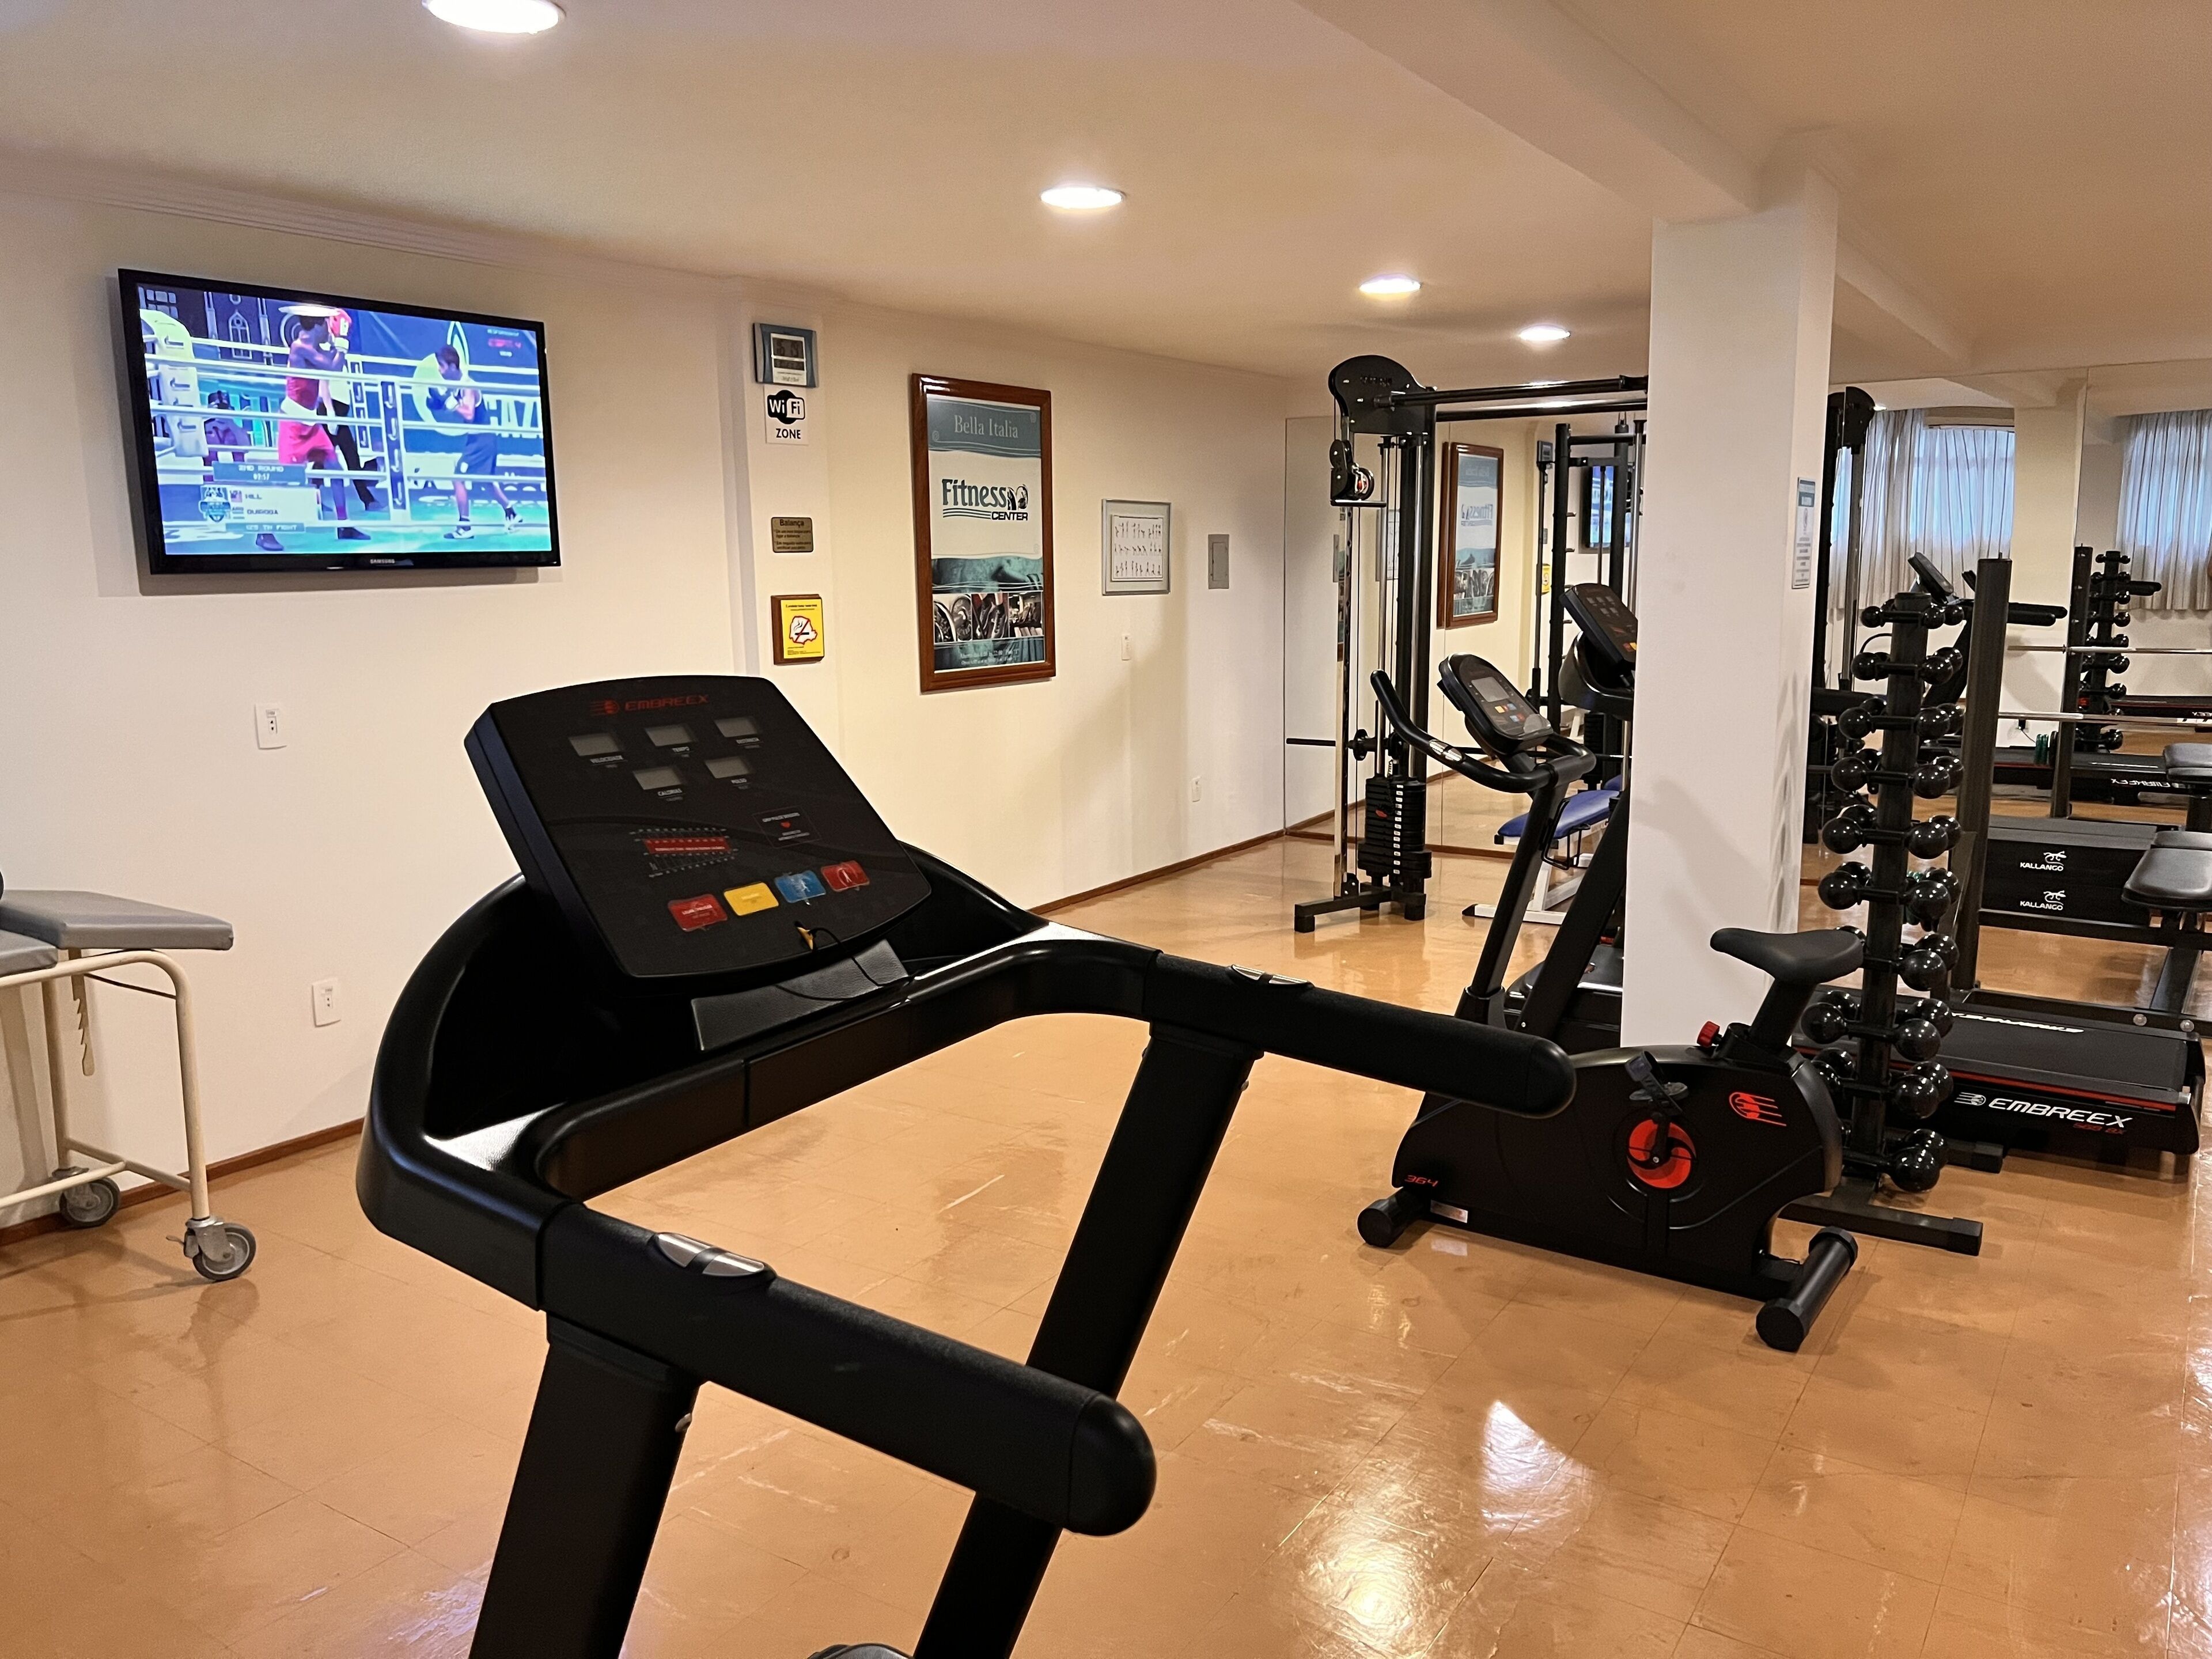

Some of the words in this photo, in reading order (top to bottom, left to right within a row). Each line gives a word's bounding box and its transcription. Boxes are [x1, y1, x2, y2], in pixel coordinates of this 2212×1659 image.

[955, 415, 984, 435] Bella
[989, 418, 1018, 438] Italia
[775, 428, 801, 439] ZONE
[942, 479, 1007, 508] Fitness
[991, 511, 1028, 521] CENTER
[779, 519, 805, 528] Balança
[624, 694, 709, 711] EMBREEX
[2020, 862, 2064, 872] KALLANGO
[2020, 900, 2063, 911] KALLANGO
[1988, 1097, 2133, 1128] EMBREEX
[1404, 1175, 1438, 1187] 364
